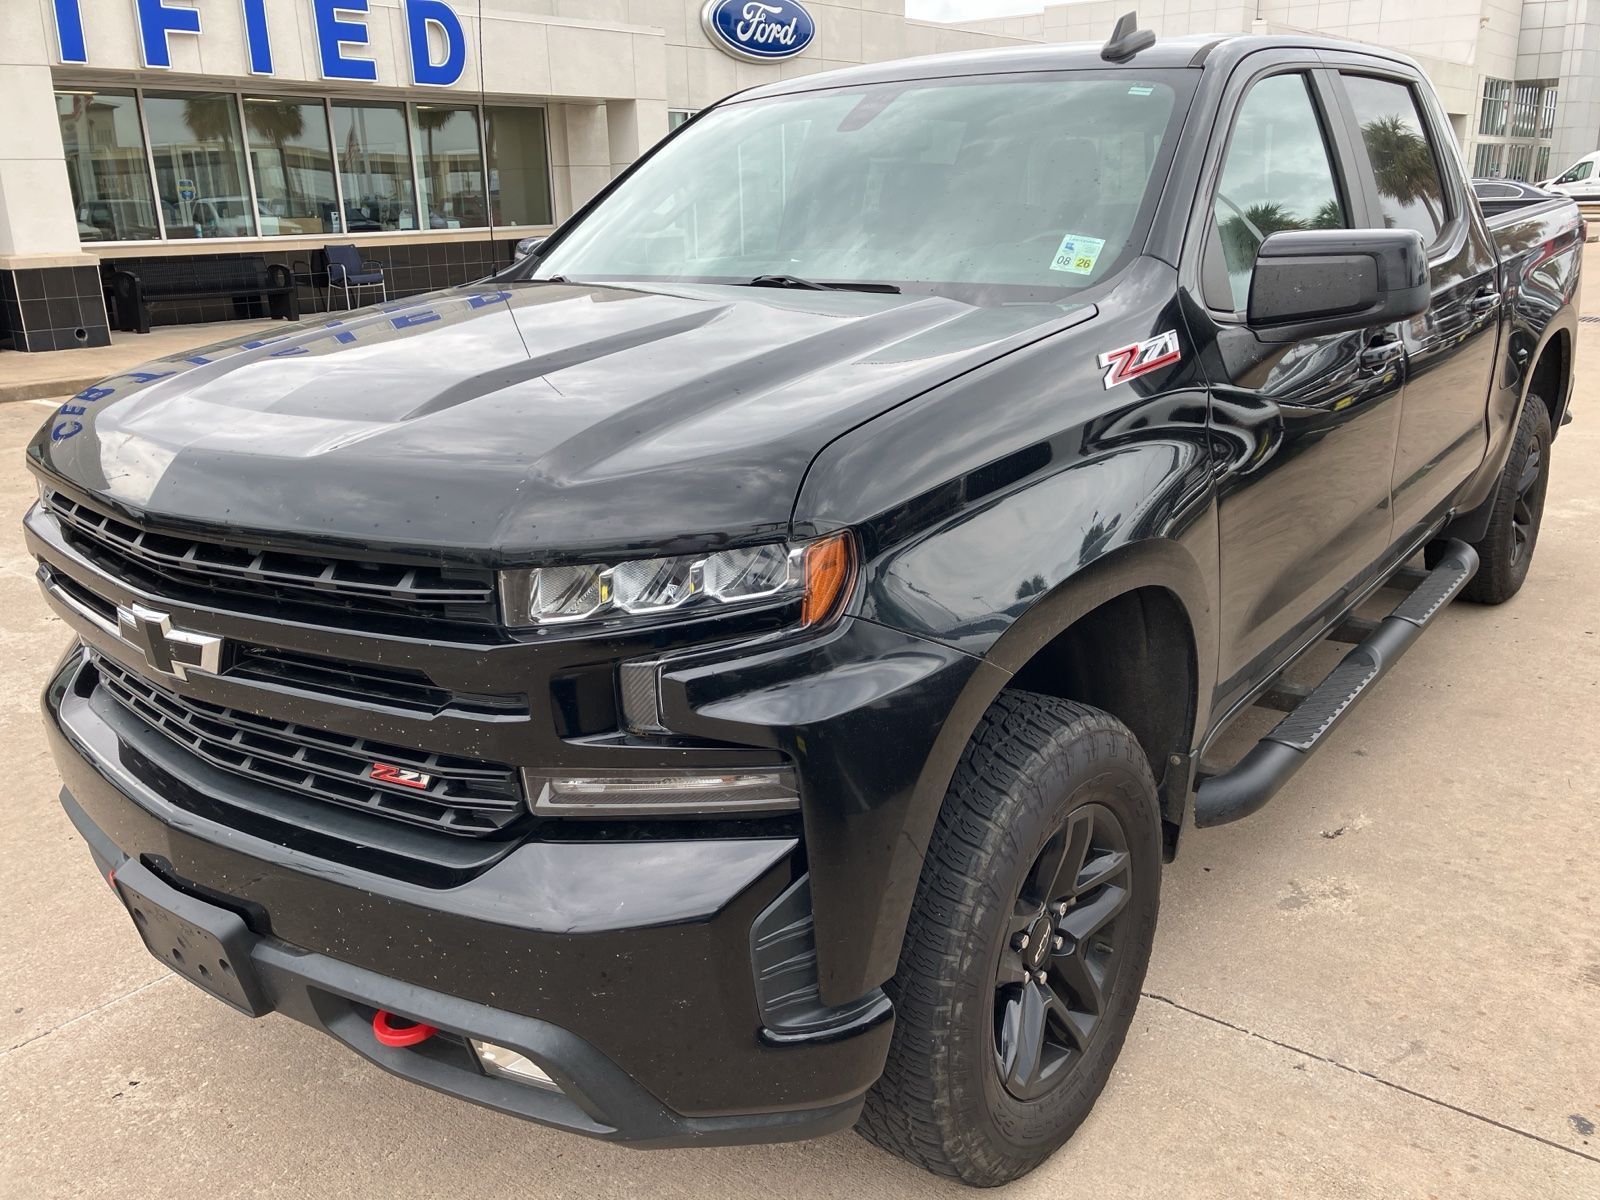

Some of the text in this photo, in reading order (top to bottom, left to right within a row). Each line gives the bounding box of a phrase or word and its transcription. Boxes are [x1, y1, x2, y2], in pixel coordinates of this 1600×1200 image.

[736, 2, 797, 45] Ford
[1056, 255, 1091, 269] 08 26
[1096, 329, 1181, 390] Z71
[369, 762, 431, 790] Z71
